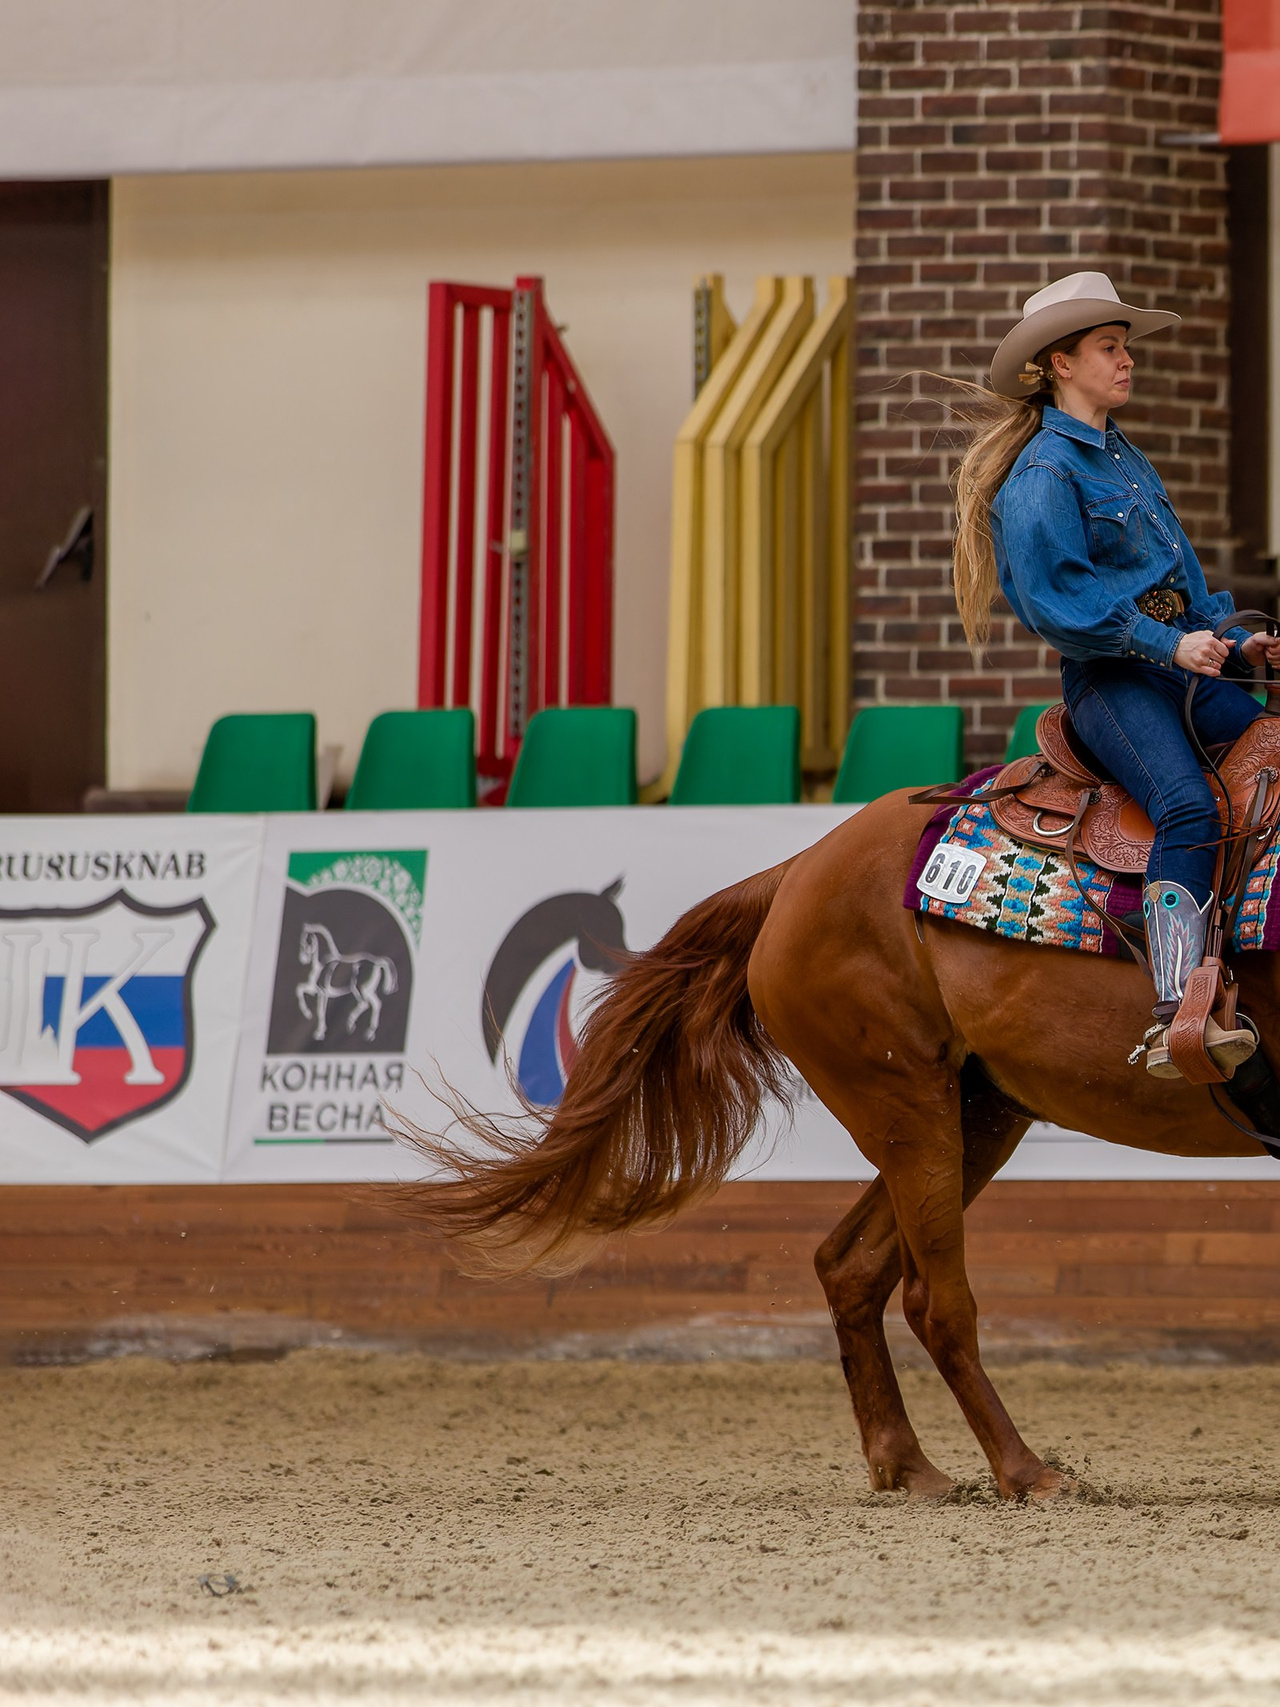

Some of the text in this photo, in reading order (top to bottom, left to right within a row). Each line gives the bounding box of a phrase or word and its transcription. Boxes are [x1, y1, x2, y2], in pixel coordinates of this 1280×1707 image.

[925, 852, 977, 895] 610
[260, 1061, 405, 1093] КОННАЯ
[267, 1102, 387, 1132] ВЕСНА
